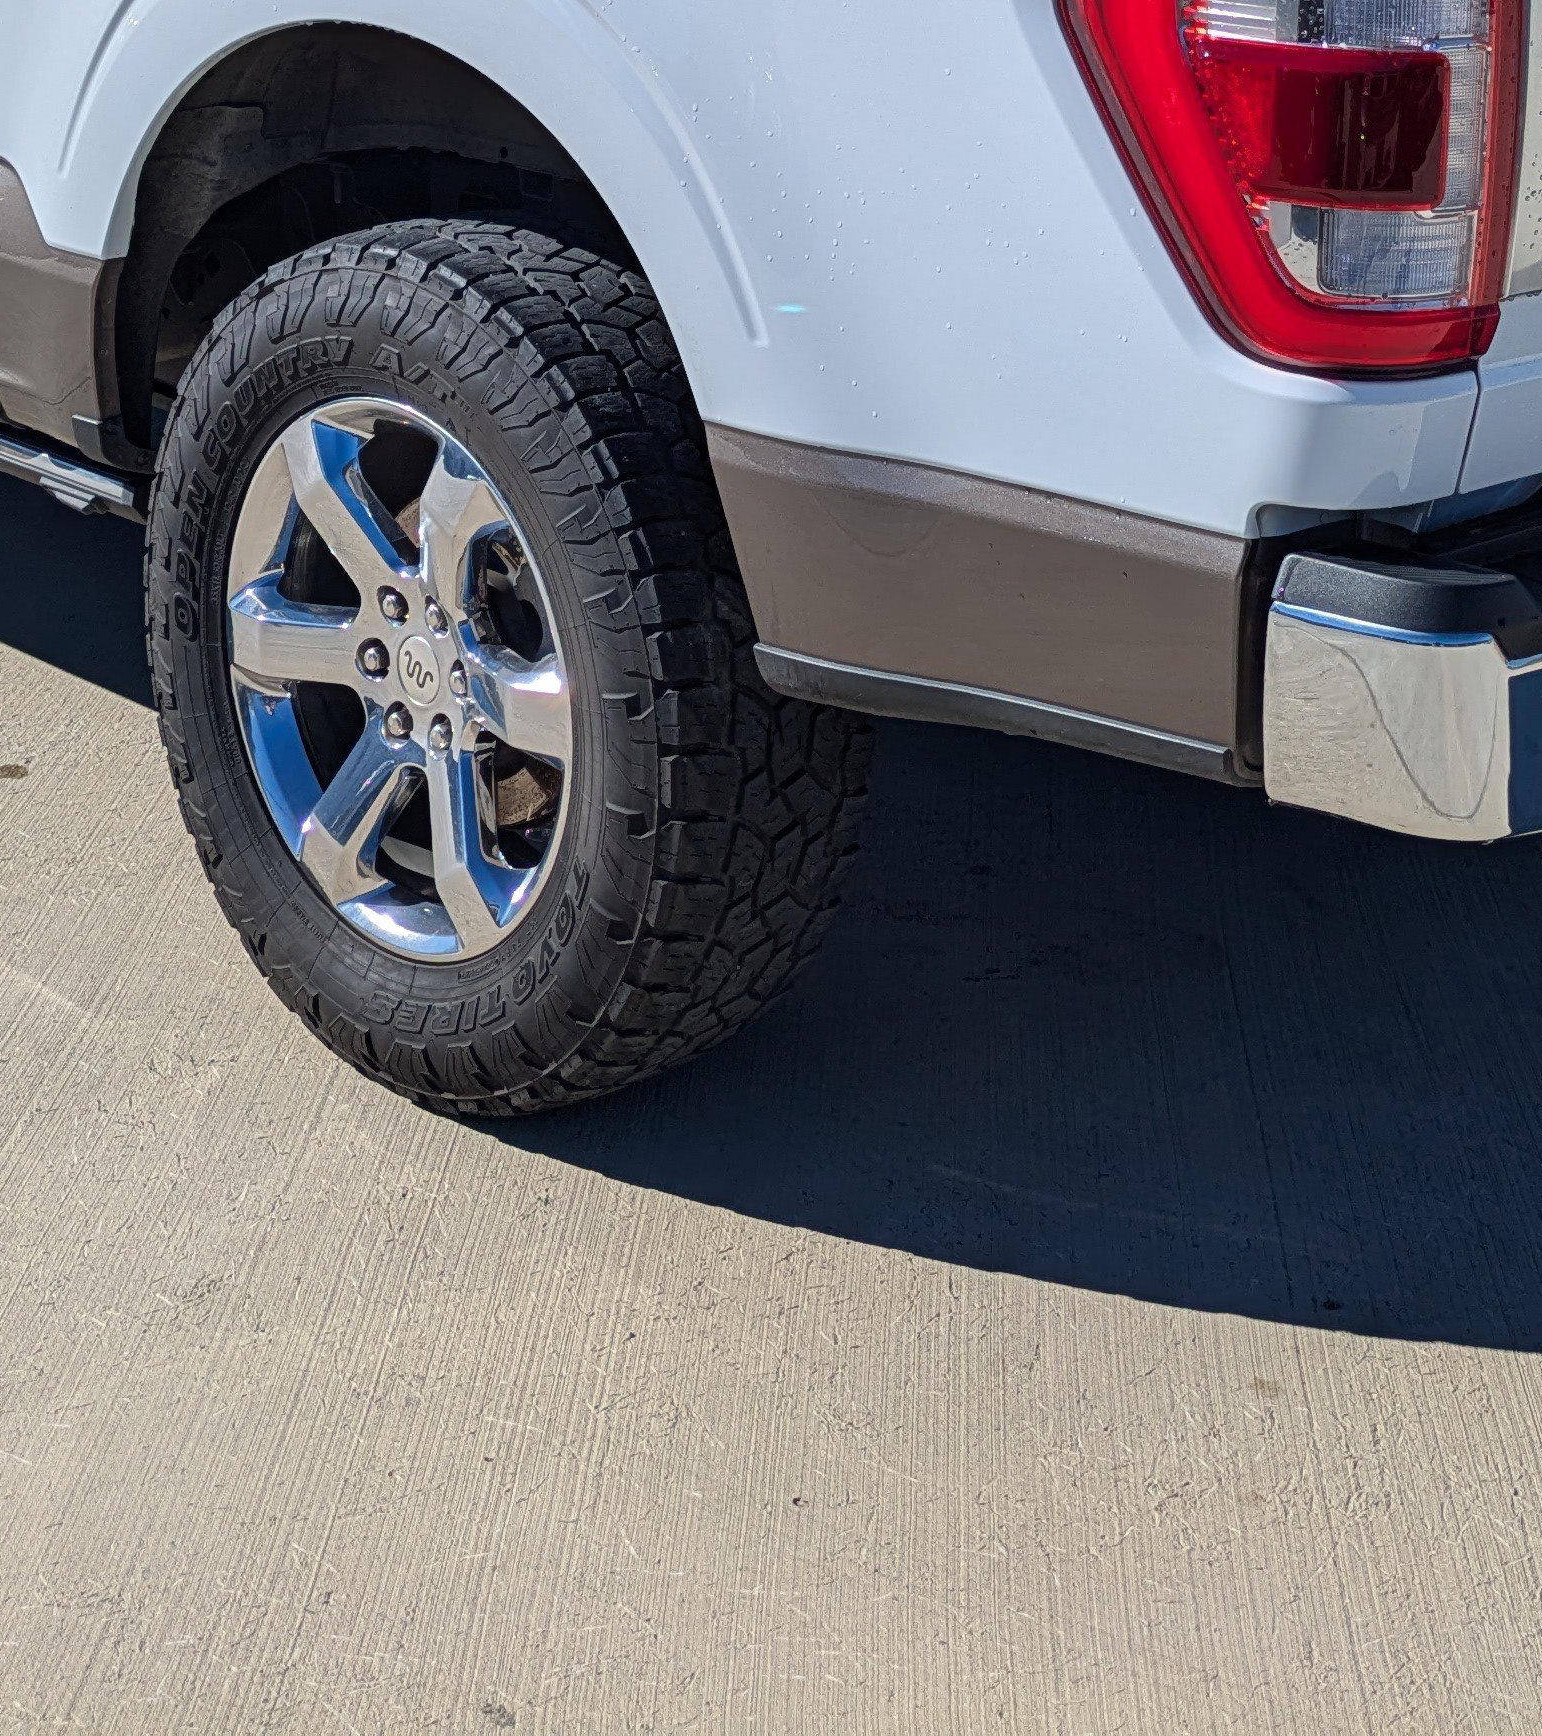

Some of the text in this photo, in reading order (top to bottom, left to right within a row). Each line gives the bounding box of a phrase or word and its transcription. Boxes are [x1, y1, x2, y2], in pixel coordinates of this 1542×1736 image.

[172, 468, 214, 641] OPEN
[202, 334, 353, 467] COUNTRY
[511, 856, 590, 1006] TOYO
[362, 984, 507, 1036] TIRES
